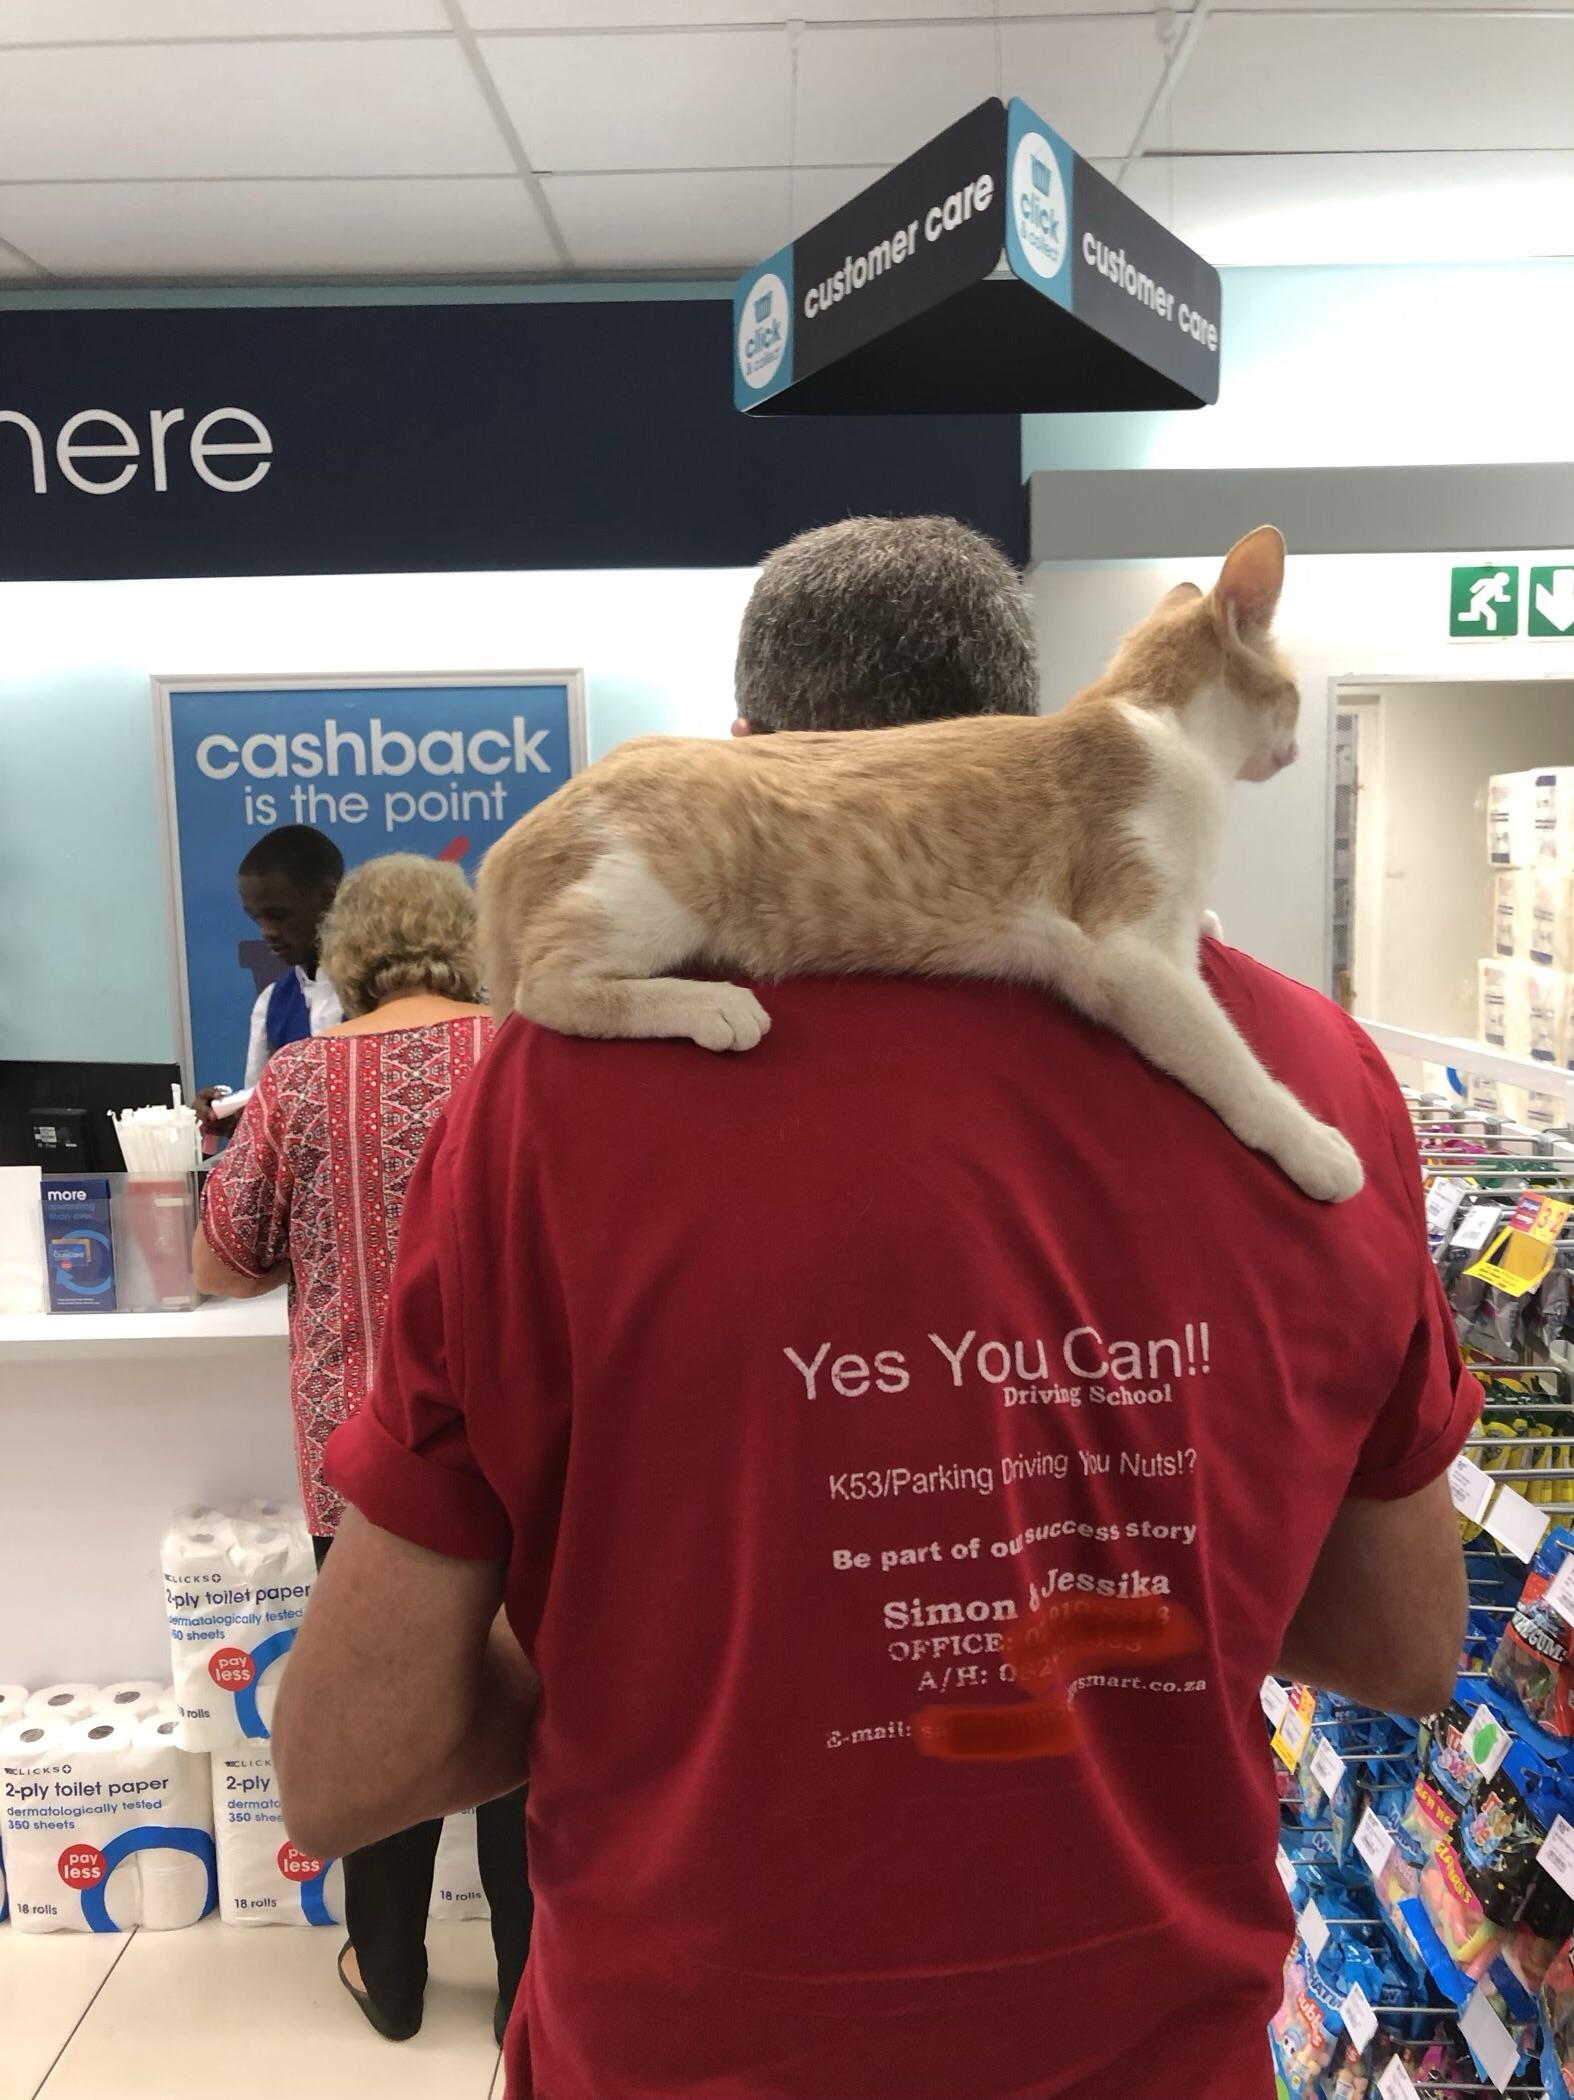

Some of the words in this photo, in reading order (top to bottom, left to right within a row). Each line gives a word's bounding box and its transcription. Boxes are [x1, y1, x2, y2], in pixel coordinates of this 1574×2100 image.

[1020, 192, 1059, 243] click
[803, 219, 919, 319] customer
[924, 174, 994, 242] care
[1082, 231, 1175, 321] customer
[1178, 303, 1217, 352] care
[745, 318, 781, 358] click
[196, 716, 551, 780] cashback
[245, 786, 277, 825] is
[290, 785, 368, 824] the
[385, 781, 508, 832] point
[47, 1190, 87, 1201] more
[784, 1342, 910, 1400] Yes
[928, 1329, 1049, 1387] You
[1063, 1321, 1210, 1382] Can!!
[1003, 1383, 1082, 1407] Driving
[1089, 1383, 1173, 1406] School
[829, 1463, 994, 1501] K53/Parking
[1001, 1451, 1069, 1486] Driving
[1079, 1450, 1110, 1477] You
[1119, 1448, 1197, 1478] Nuts!?
[832, 1548, 872, 1571] Be
[881, 1541, 943, 1572] part
[950, 1537, 981, 1560] of
[1024, 1520, 1120, 1544] success
[1125, 1521, 1197, 1545] story
[205, 1588, 250, 1605] toilet
[256, 1584, 311, 1605] paper
[883, 1598, 1019, 1631] Simon
[1041, 1568, 1171, 1599] Jessika
[187, 1629, 225, 1641] sheets
[218, 1657, 248, 1669] pay
[215, 1669, 251, 1682] less
[917, 1664, 989, 1693] A/H:
[187, 1708, 211, 1719] rolls
[826, 1720, 912, 1749] E-mail:
[9, 1766, 61, 1776] CLICKS
[232, 1759, 272, 1768] CLICK
[5, 1782, 49, 1801] 2-ply
[55, 1782, 102, 1797] toilet
[108, 1778, 169, 1797] paper
[226, 1775, 271, 1793] 2-ply
[7, 1803, 118, 1818] dermatologically
[122, 1799, 162, 1810] tested
[229, 1812, 251, 1823] 350
[255, 1812, 284, 1823] shee
[8, 1819, 30, 1830] 350
[34, 1819, 76, 1830] sheets
[69, 1853, 98, 1865] pay
[283, 1858, 321, 1873] less
[63, 1865, 101, 1879] less
[234, 1898, 248, 1909] 18
[250, 1898, 277, 1909] rolls
[440, 1890, 453, 1901] 18
[455, 1891, 482, 1901] rolls
[17, 1903, 30, 1915] 18
[32, 1904, 58, 1915] rolls
